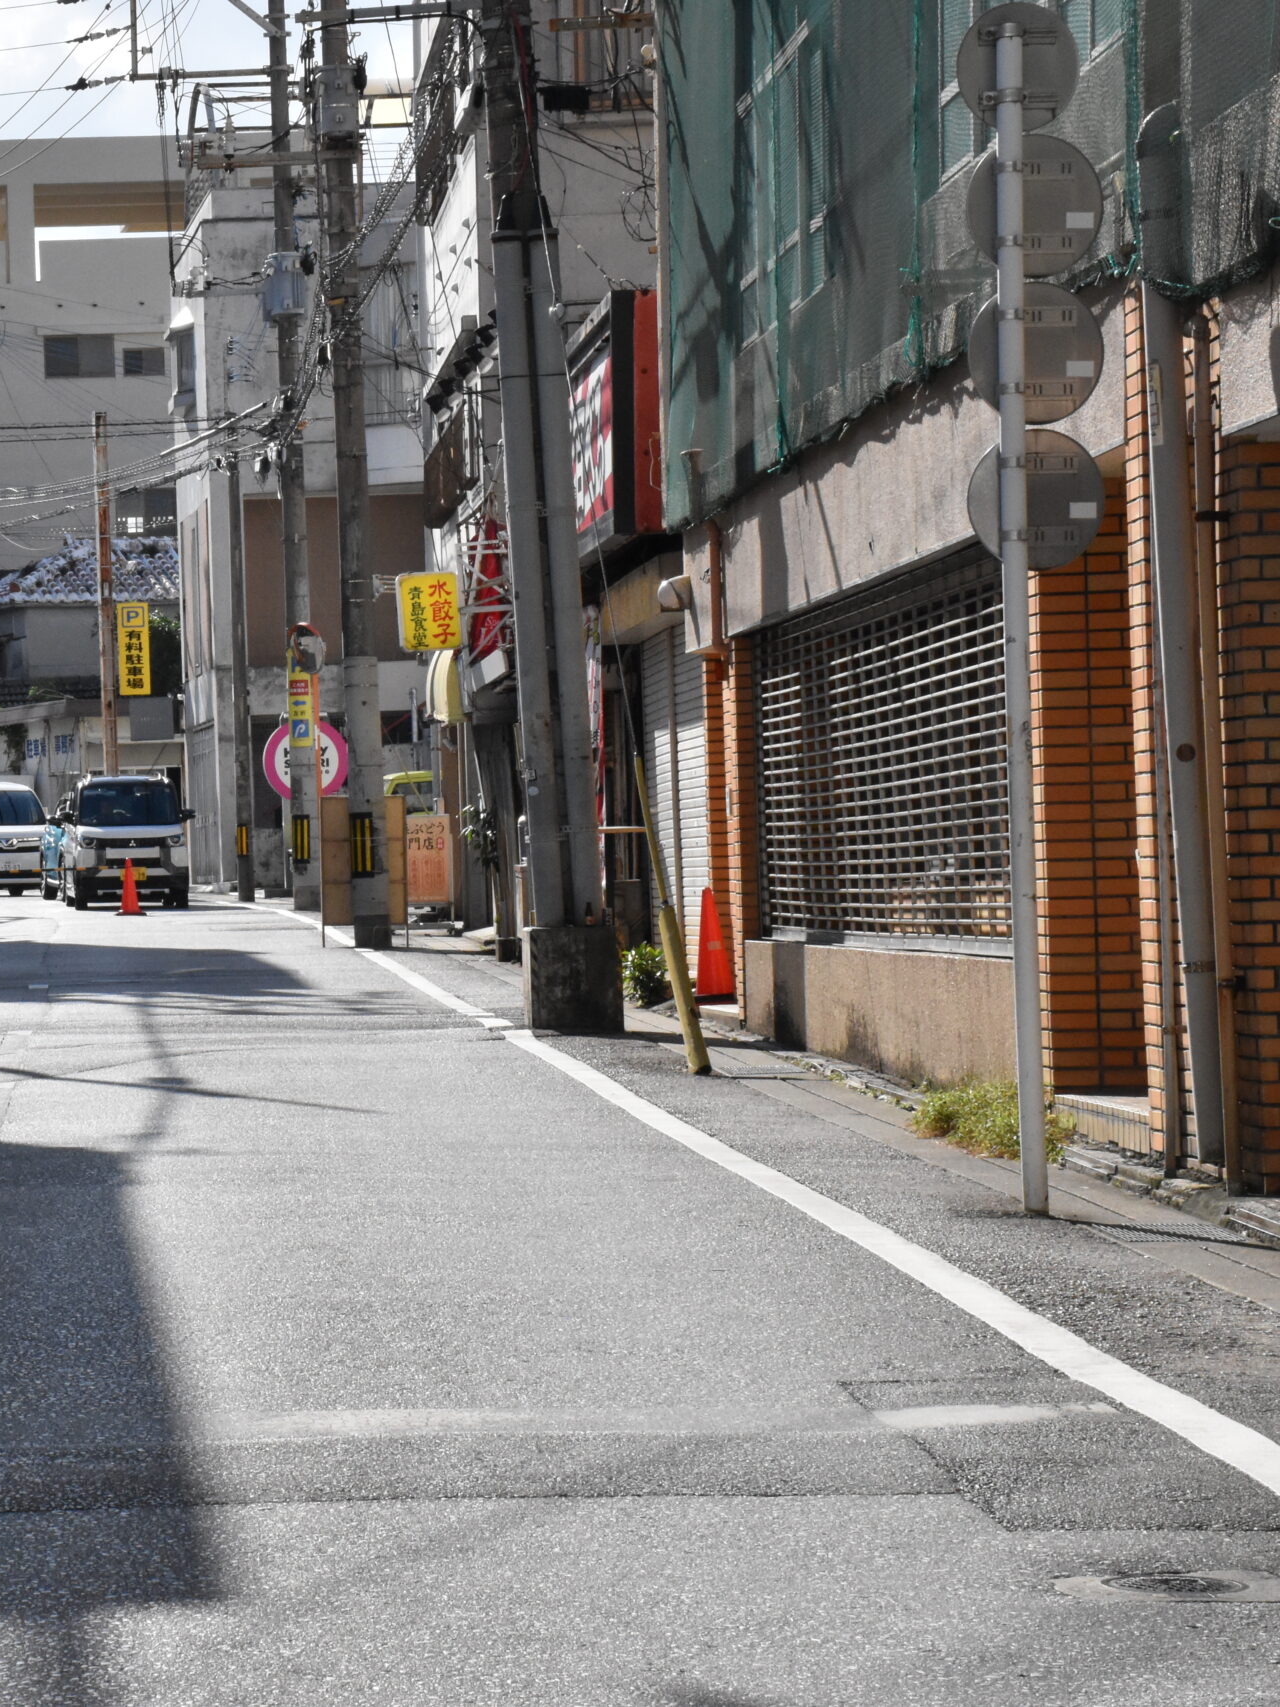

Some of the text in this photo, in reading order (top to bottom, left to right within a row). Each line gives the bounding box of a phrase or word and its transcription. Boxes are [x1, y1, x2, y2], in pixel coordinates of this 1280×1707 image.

[127, 611, 139, 624] P
[407, 586, 430, 649] 青島食堂
[428, 579, 457, 645] 水餃子
[125, 630, 145, 690] 有料駐車場
[407, 837, 434, 850] 門店
